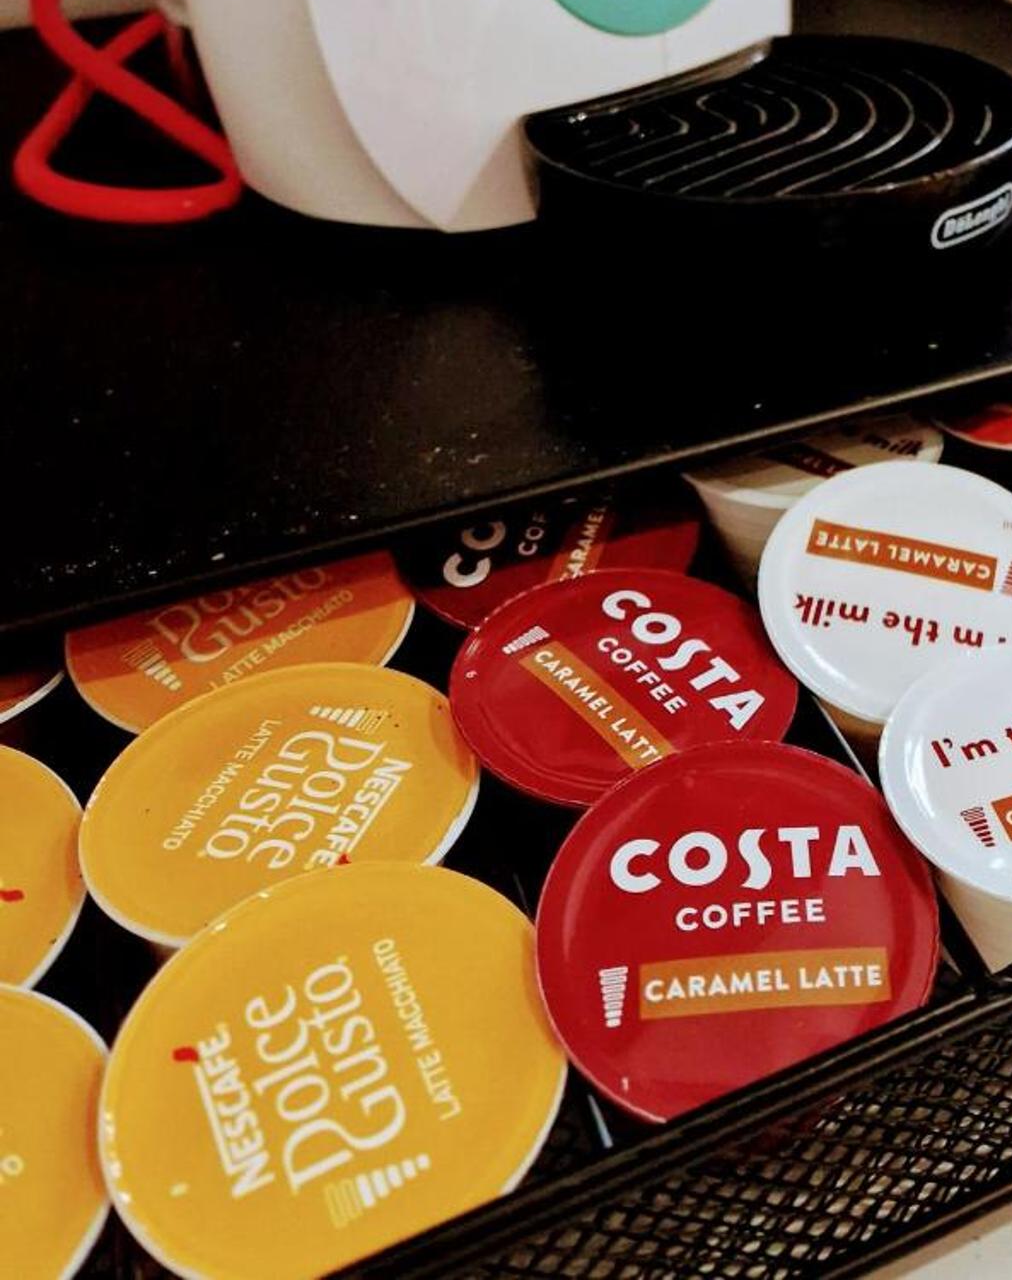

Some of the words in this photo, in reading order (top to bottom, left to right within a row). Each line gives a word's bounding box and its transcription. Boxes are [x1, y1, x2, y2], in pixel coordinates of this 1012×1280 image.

[815, 529, 880, 558] LATTE
[888, 543, 992, 581] CARAMEL
[264, 588, 354, 656] MACCHIATO
[795, 593, 870, 627] milk
[882, 611, 939, 647] the
[597, 637, 688, 715] COFFEE
[601, 589, 767, 732] COSTA
[236, 719, 282, 762] LATTE
[534, 650, 614, 720] CARAMEL
[610, 717, 664, 765] LATT
[931, 736, 998, 769] I'm
[163, 761, 246, 851] MACCHIATO
[203, 729, 335, 860] Gusto
[247, 735, 387, 870] Dolce
[610, 825, 881, 894] COSTA
[676, 897, 826, 932] COFFEE
[372, 937, 432, 1052] MACCHIATO
[644, 968, 791, 1003] CARAMEL
[799, 964, 884, 990] LATTE
[245, 984, 353, 1196] Dolce
[304, 961, 406, 1150] Gusto
[417, 1050, 462, 1121] LATTE
